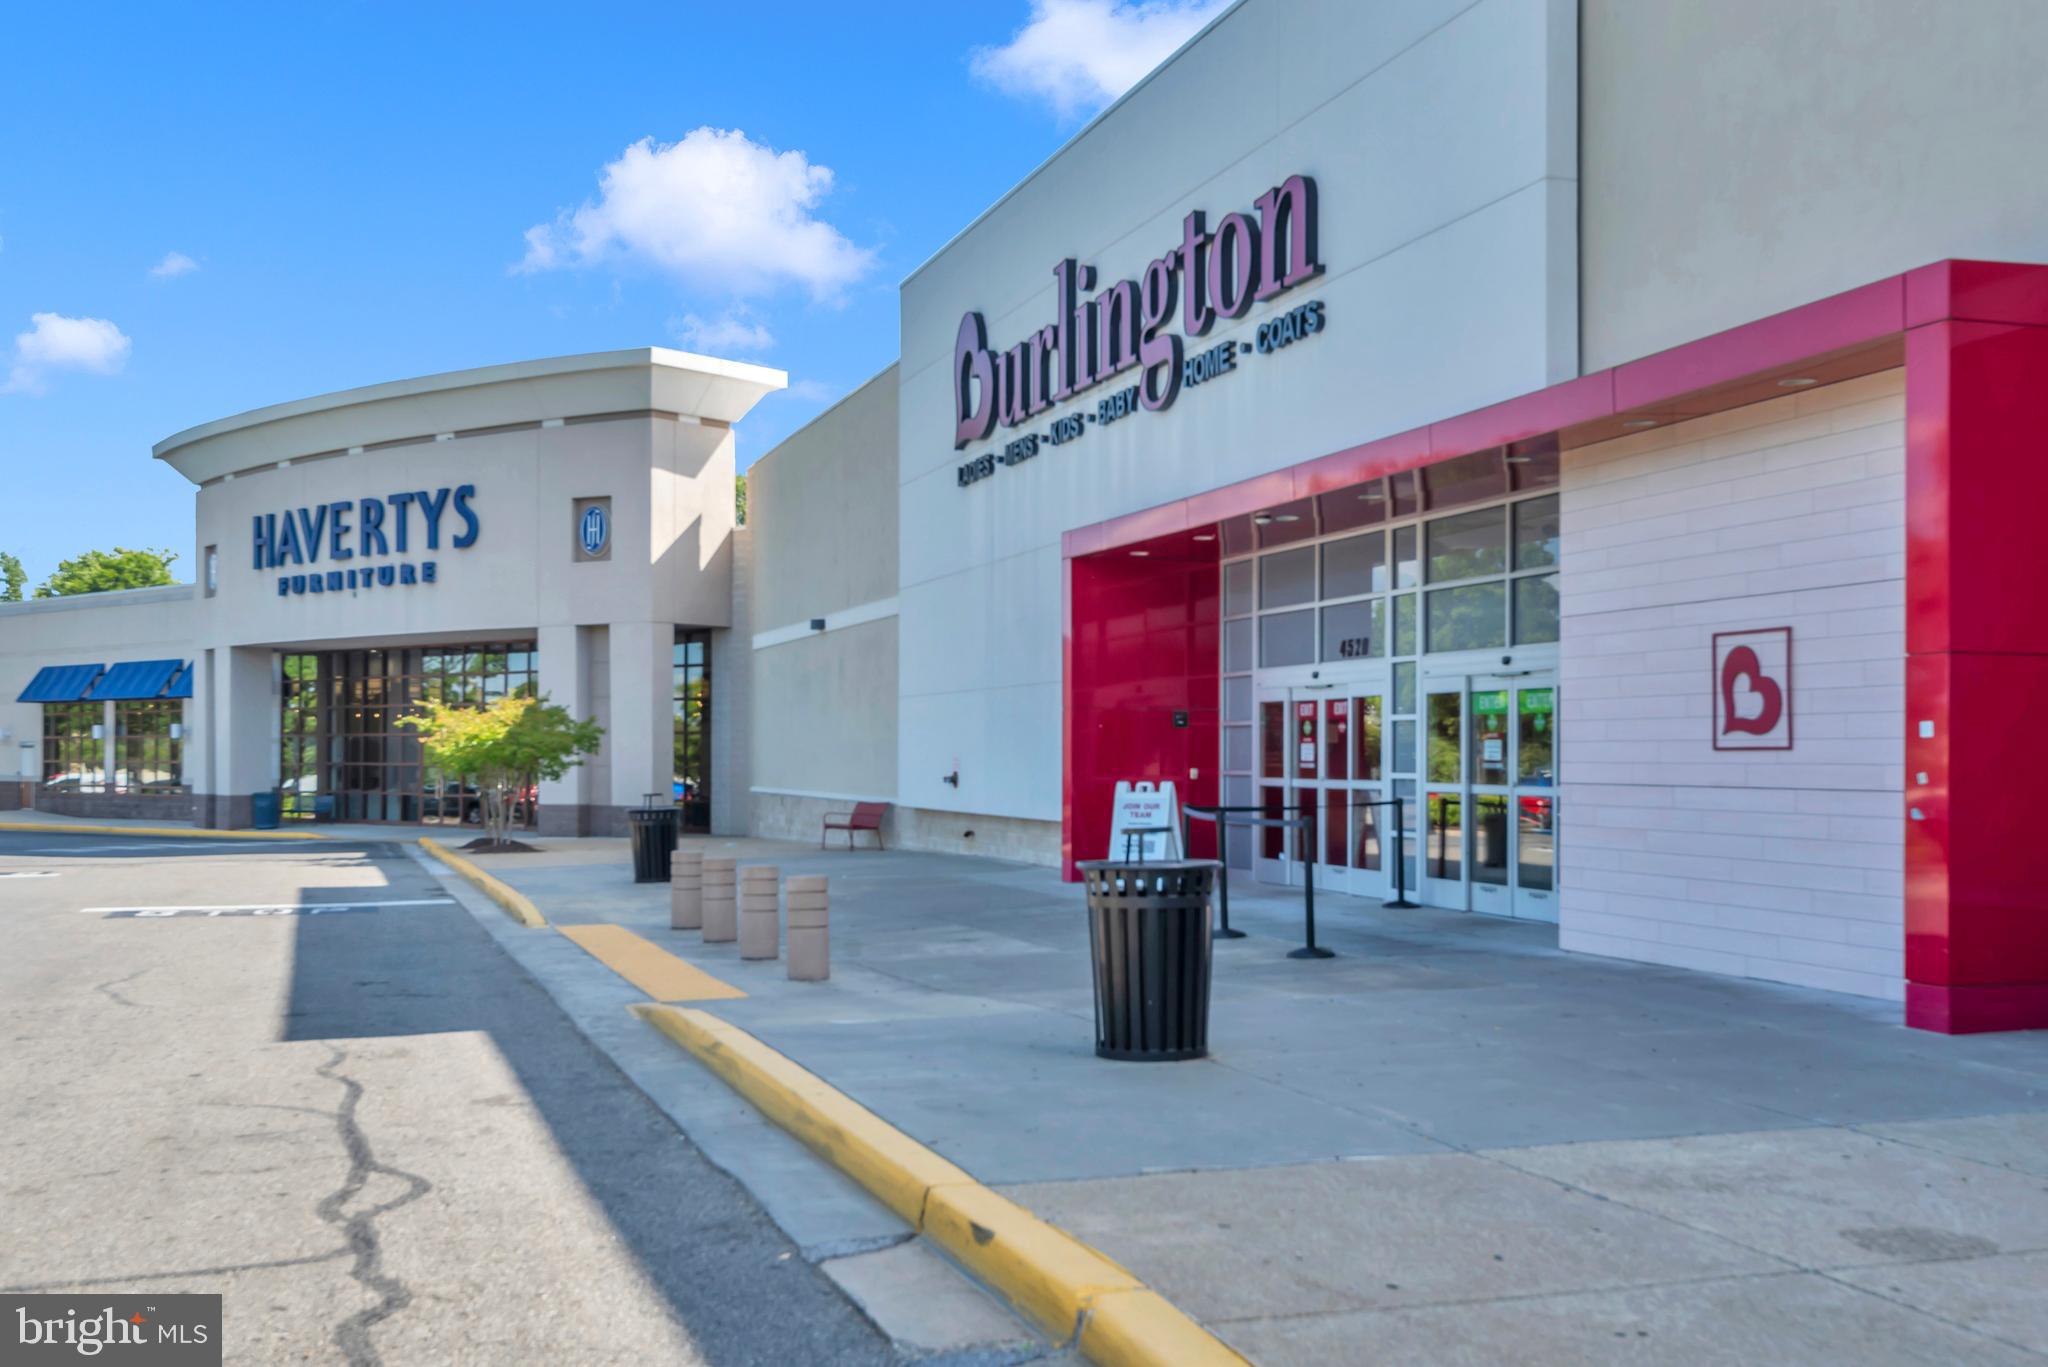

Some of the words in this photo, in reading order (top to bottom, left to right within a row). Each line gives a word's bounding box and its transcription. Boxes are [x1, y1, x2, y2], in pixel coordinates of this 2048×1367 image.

[954, 174, 1326, 450] Burlington
[1050, 412, 1085, 446] KIDS
[1098, 387, 1138, 426] BABY
[1183, 340, 1237, 388] HOME
[1256, 300, 1326, 354] COATS
[252, 484, 480, 570] HAVERTYS
[277, 561, 437, 597] FURNITURE
